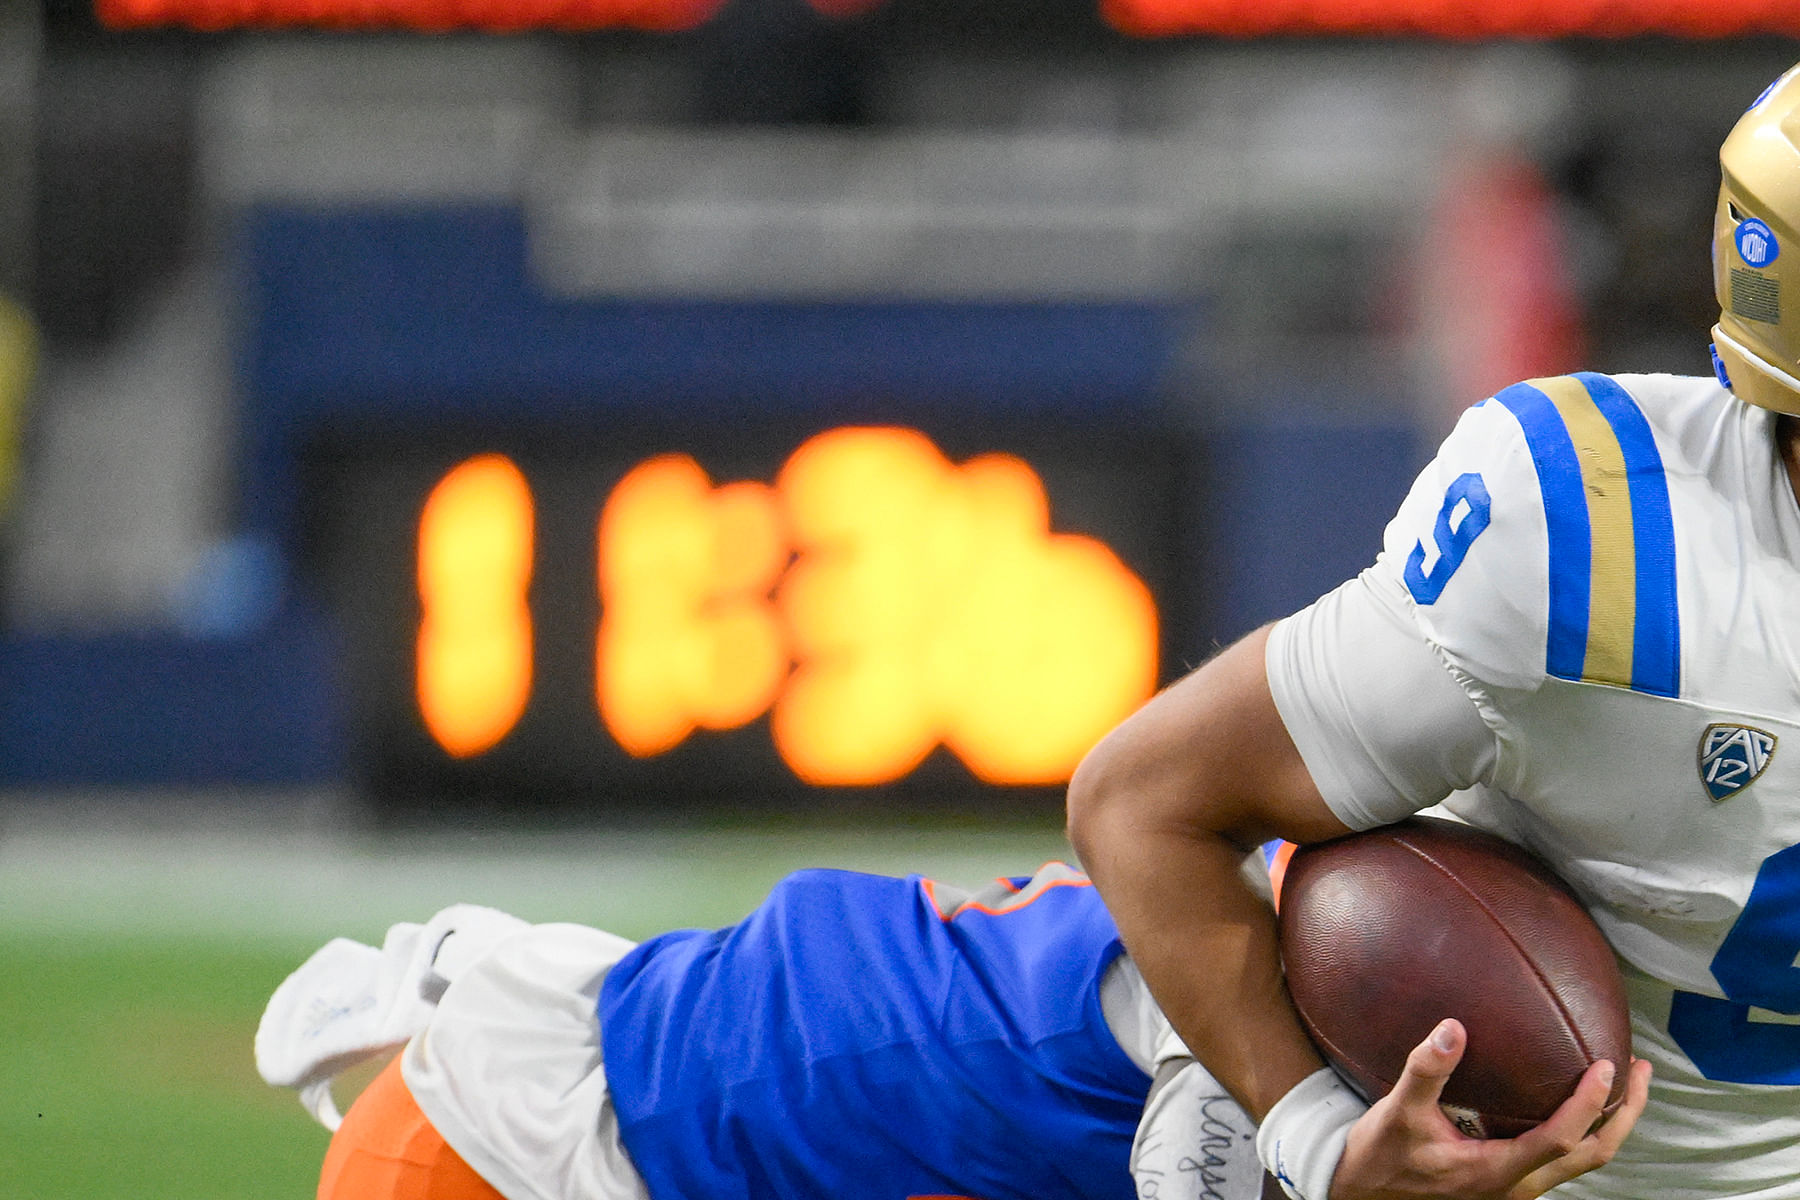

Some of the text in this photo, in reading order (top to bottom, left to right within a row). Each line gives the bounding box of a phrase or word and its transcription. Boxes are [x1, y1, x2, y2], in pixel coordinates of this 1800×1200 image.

[1403, 472, 1491, 605] 9
[1702, 727, 1775, 778] PAC
[1706, 757, 1749, 789] 12
